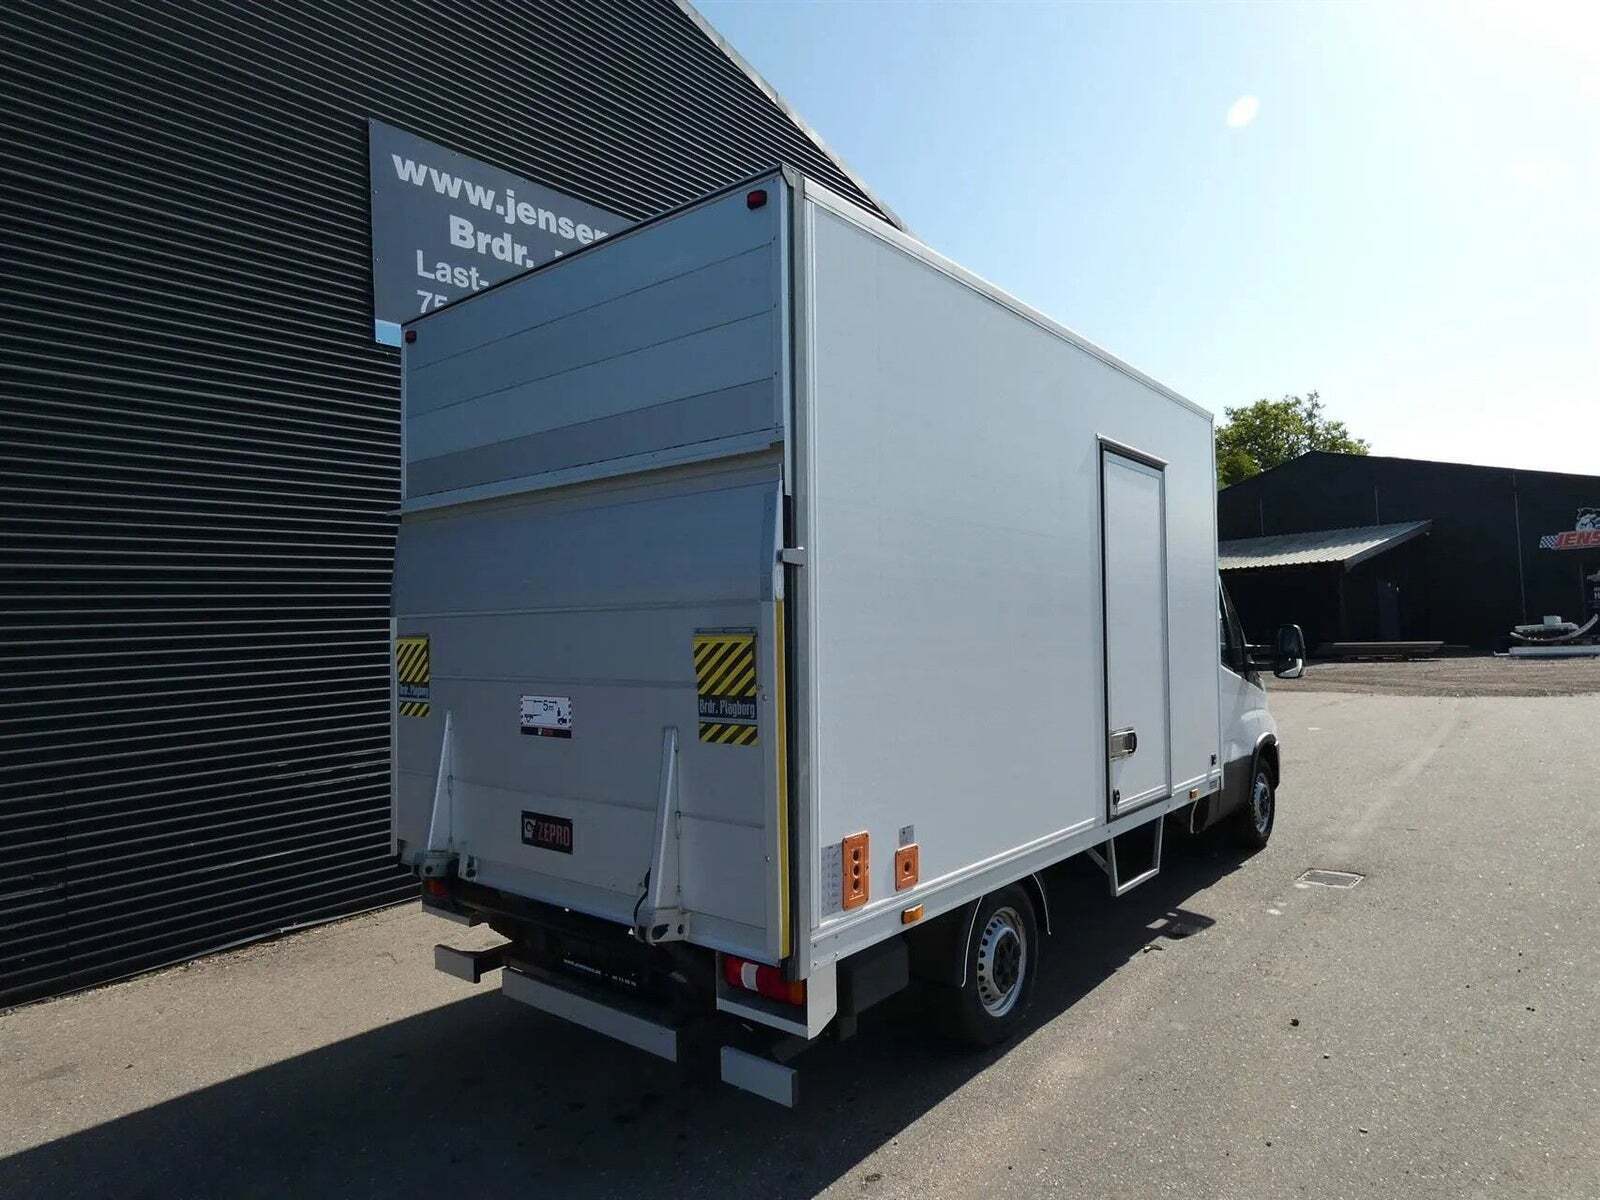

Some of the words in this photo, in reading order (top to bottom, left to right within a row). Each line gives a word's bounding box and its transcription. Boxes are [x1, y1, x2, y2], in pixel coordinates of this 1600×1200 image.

[448, 213, 534, 269] Brdr.
[416, 249, 490, 290] Last-
[537, 821, 570, 847] ZEPRO
